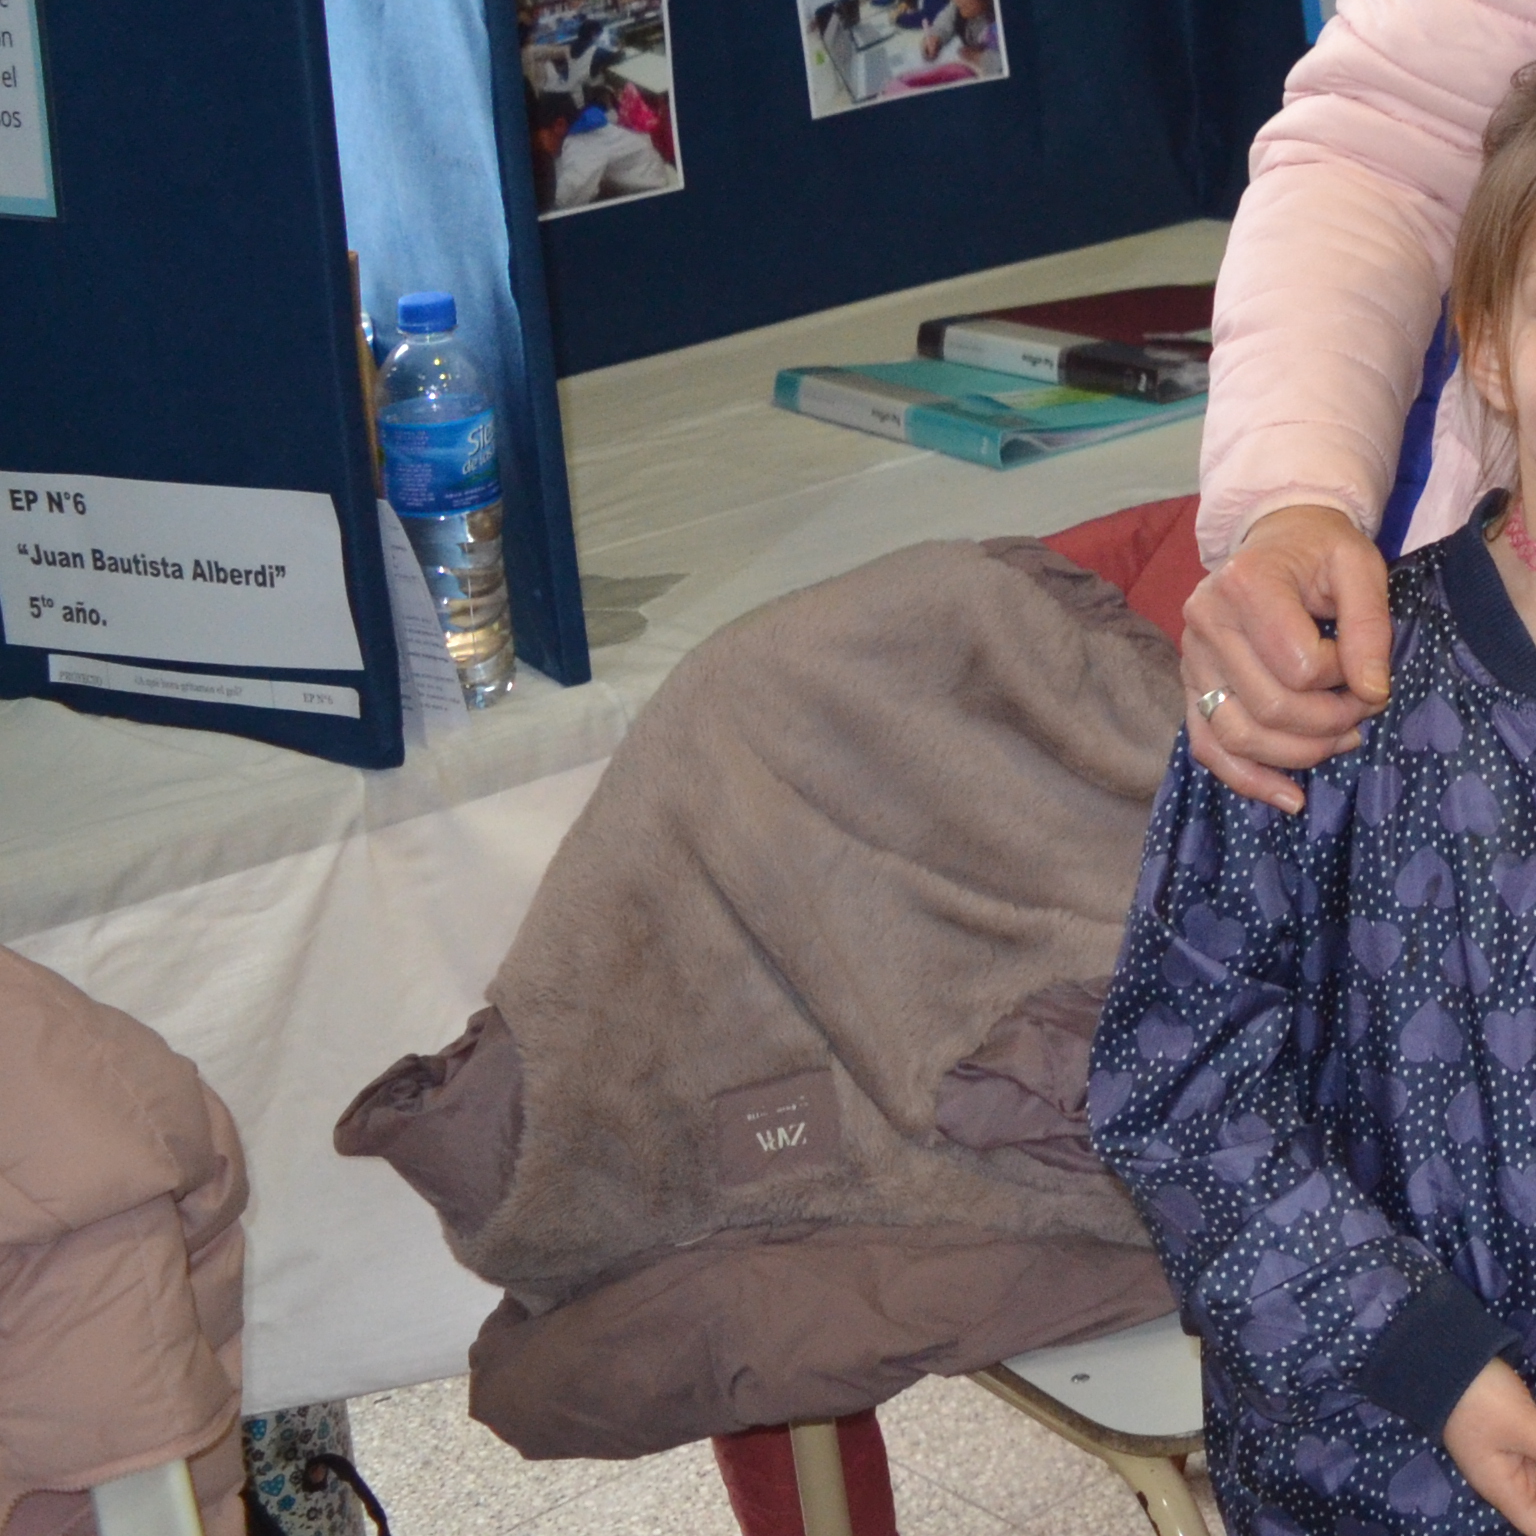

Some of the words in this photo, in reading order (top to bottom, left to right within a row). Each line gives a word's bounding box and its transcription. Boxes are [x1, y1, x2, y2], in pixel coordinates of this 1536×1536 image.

[9, 489, 37, 511] EP
[46, 491, 86, 515] N°6
[91, 549, 184, 580] Bautista
[62, 602, 108, 627] año.
